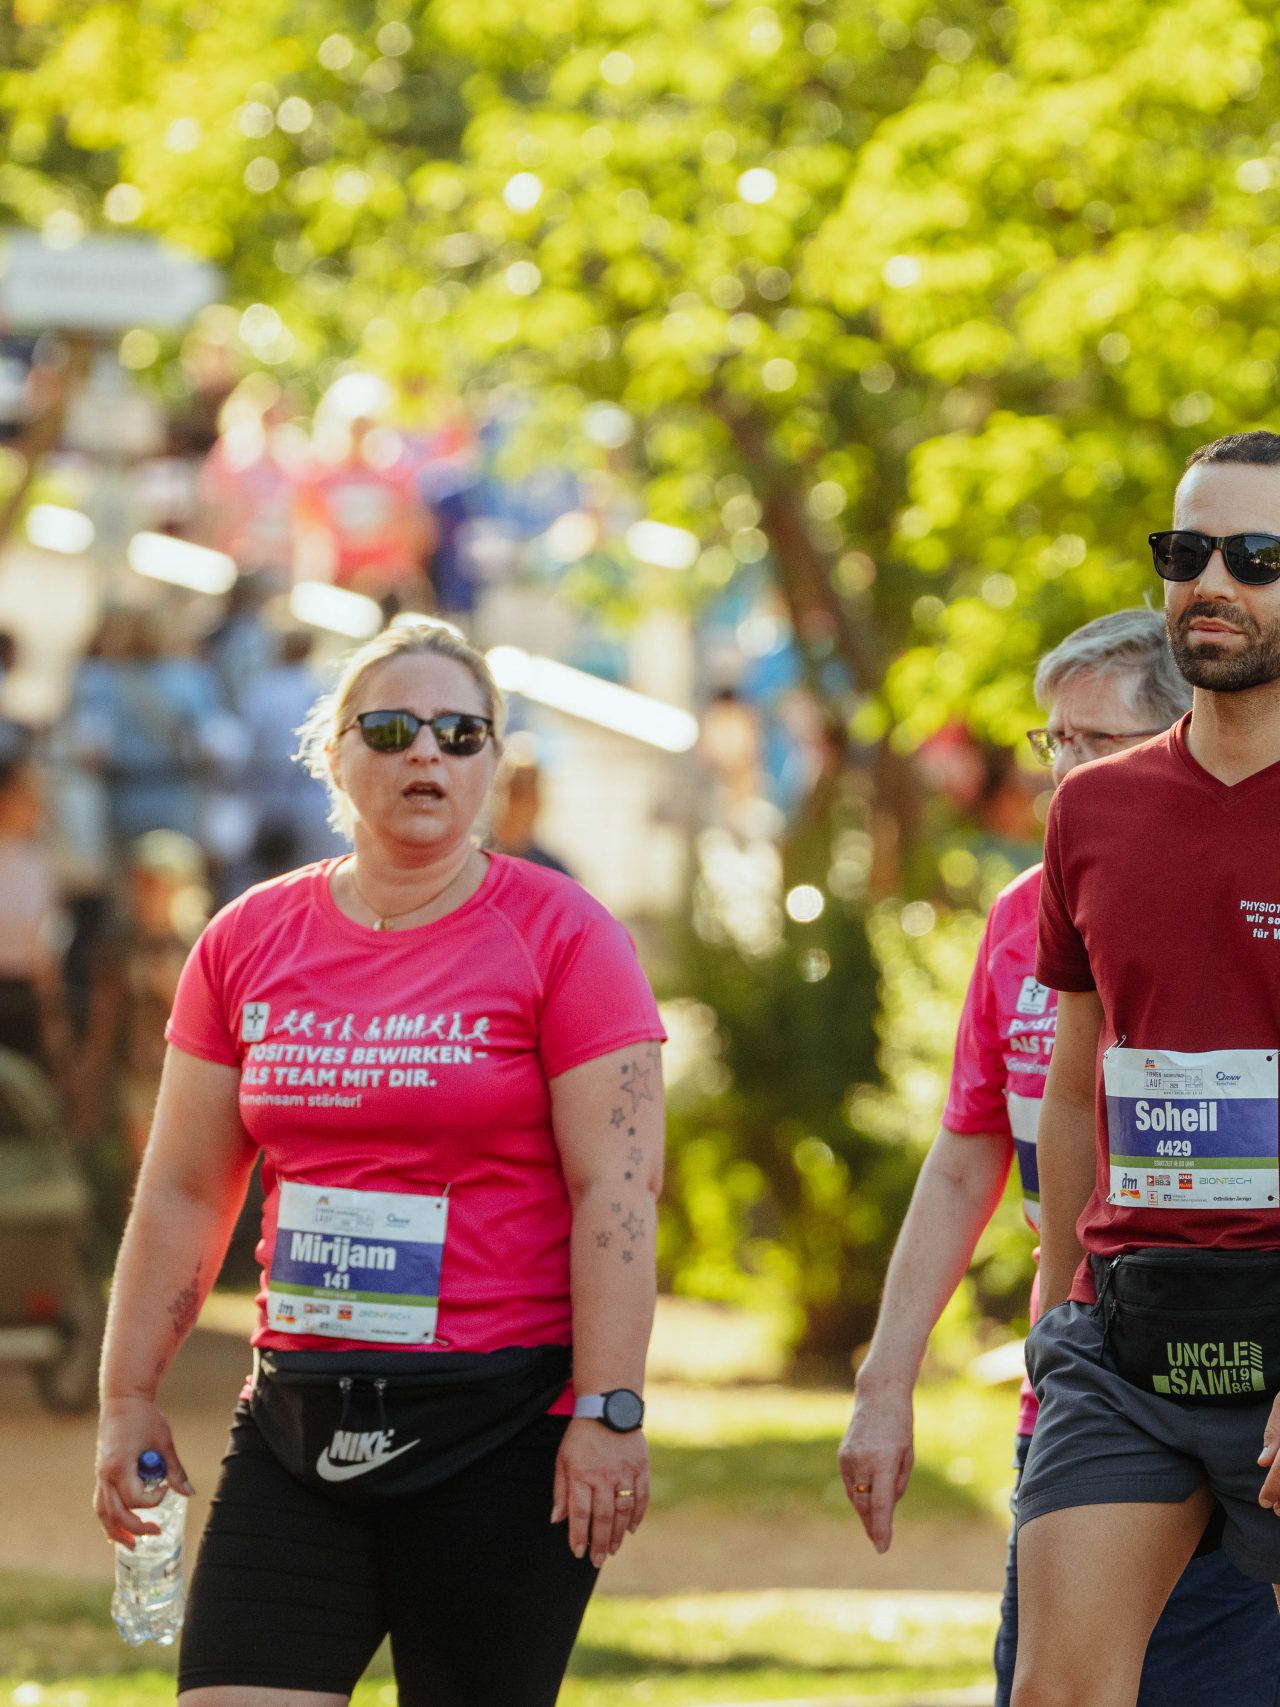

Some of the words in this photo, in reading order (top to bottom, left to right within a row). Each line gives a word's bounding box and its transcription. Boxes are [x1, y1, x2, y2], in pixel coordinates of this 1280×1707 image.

[1246, 913, 1264, 923] wir
[1252, 928, 1269, 939] für
[273, 1066, 338, 1088] TEAM
[341, 1068, 384, 1089] MIT
[388, 1068, 437, 1089] DIR.
[1135, 1100, 1218, 1132] Soheil
[1156, 1140, 1192, 1157] 4429
[1121, 1173, 1138, 1190] dm
[1199, 1177, 1252, 1185] BIONTECH
[290, 1232, 397, 1272] Mirijam
[323, 1272, 350, 1289] 141
[1167, 1341, 1249, 1367] UNCLE
[1170, 1368, 1232, 1395] SAM
[1231, 1382, 1252, 1394] 86
[328, 1428, 396, 1462] NIKE
